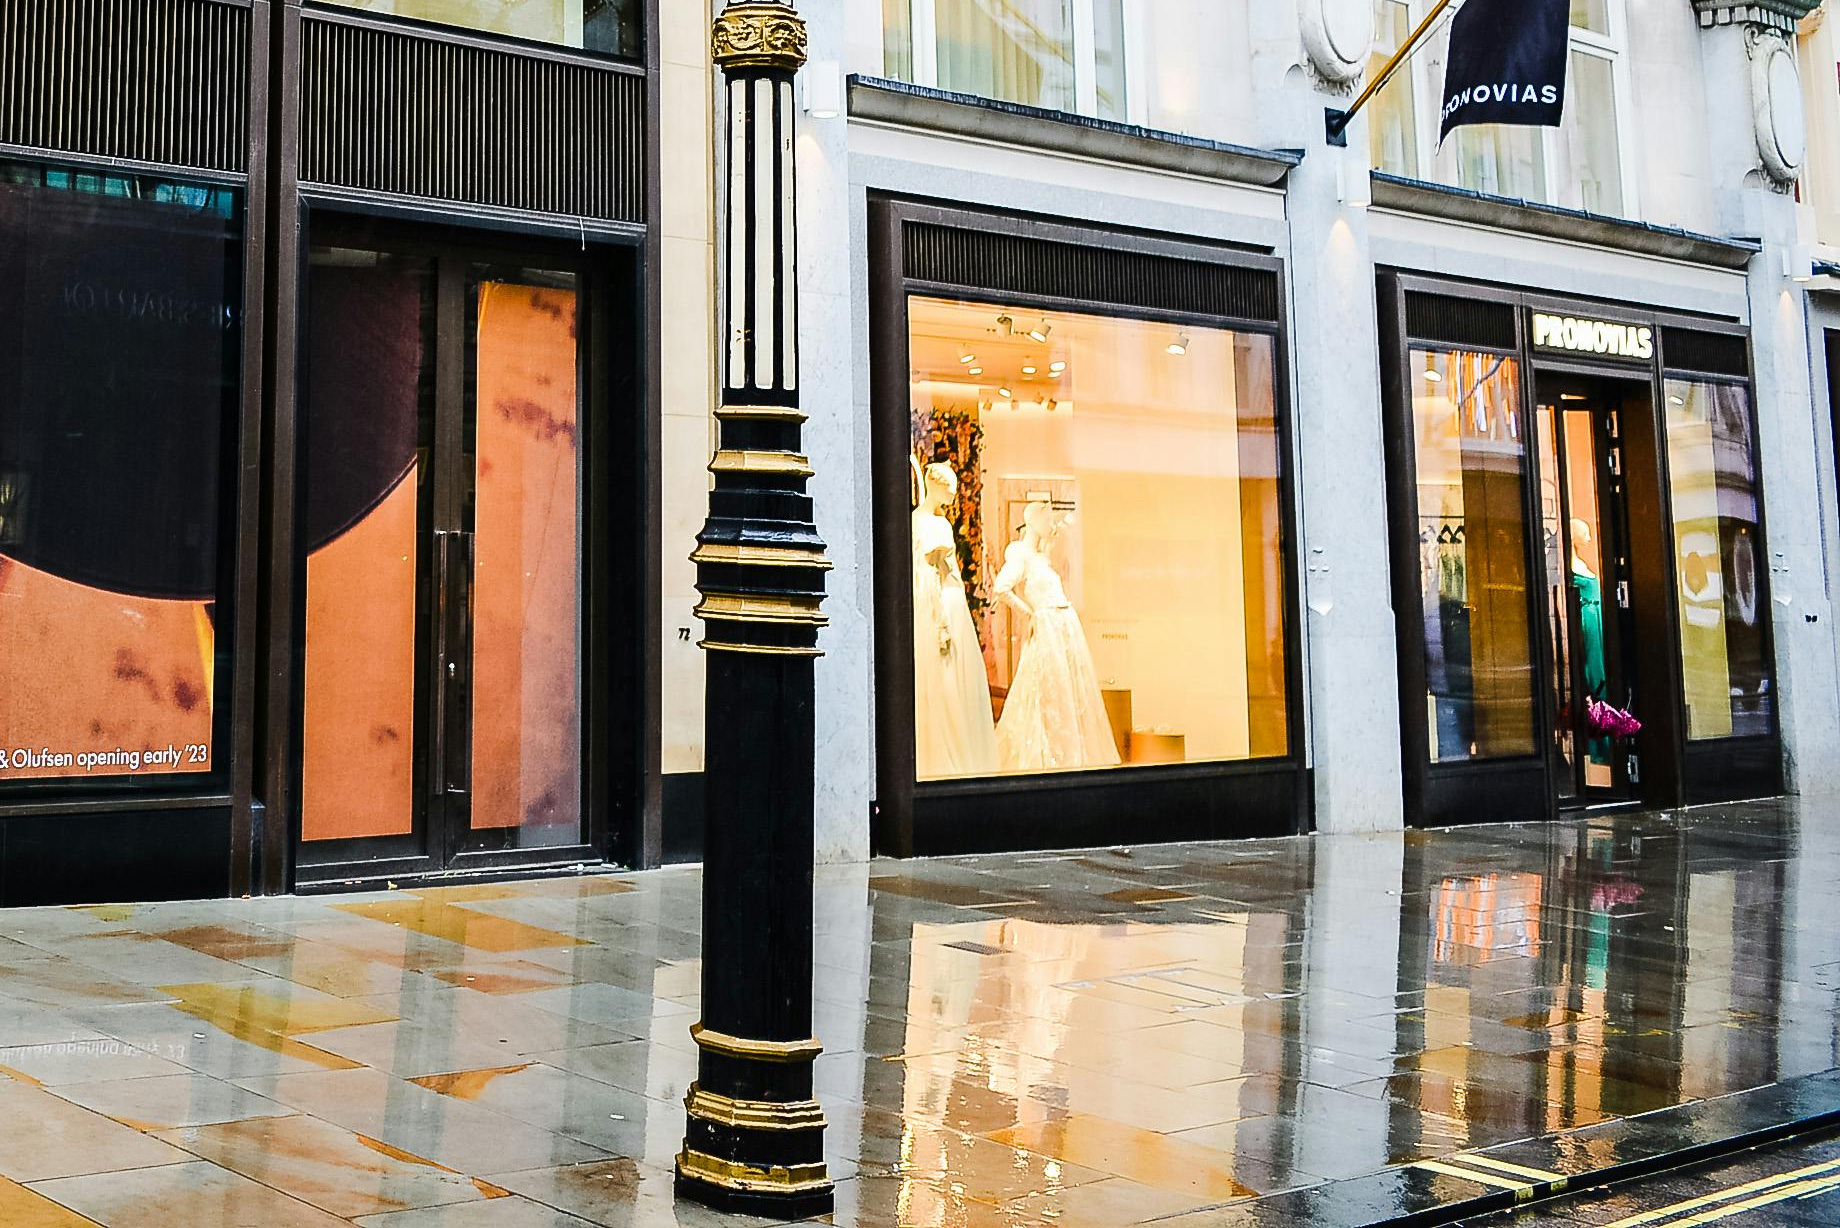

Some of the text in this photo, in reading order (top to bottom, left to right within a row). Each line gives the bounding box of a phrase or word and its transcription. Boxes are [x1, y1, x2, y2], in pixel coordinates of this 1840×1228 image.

[1534, 313, 1653, 359] PRONOVIAS
[11, 747, 73, 768] Olufsen
[76, 748, 140, 771] opening
[143, 744, 183, 768] early
